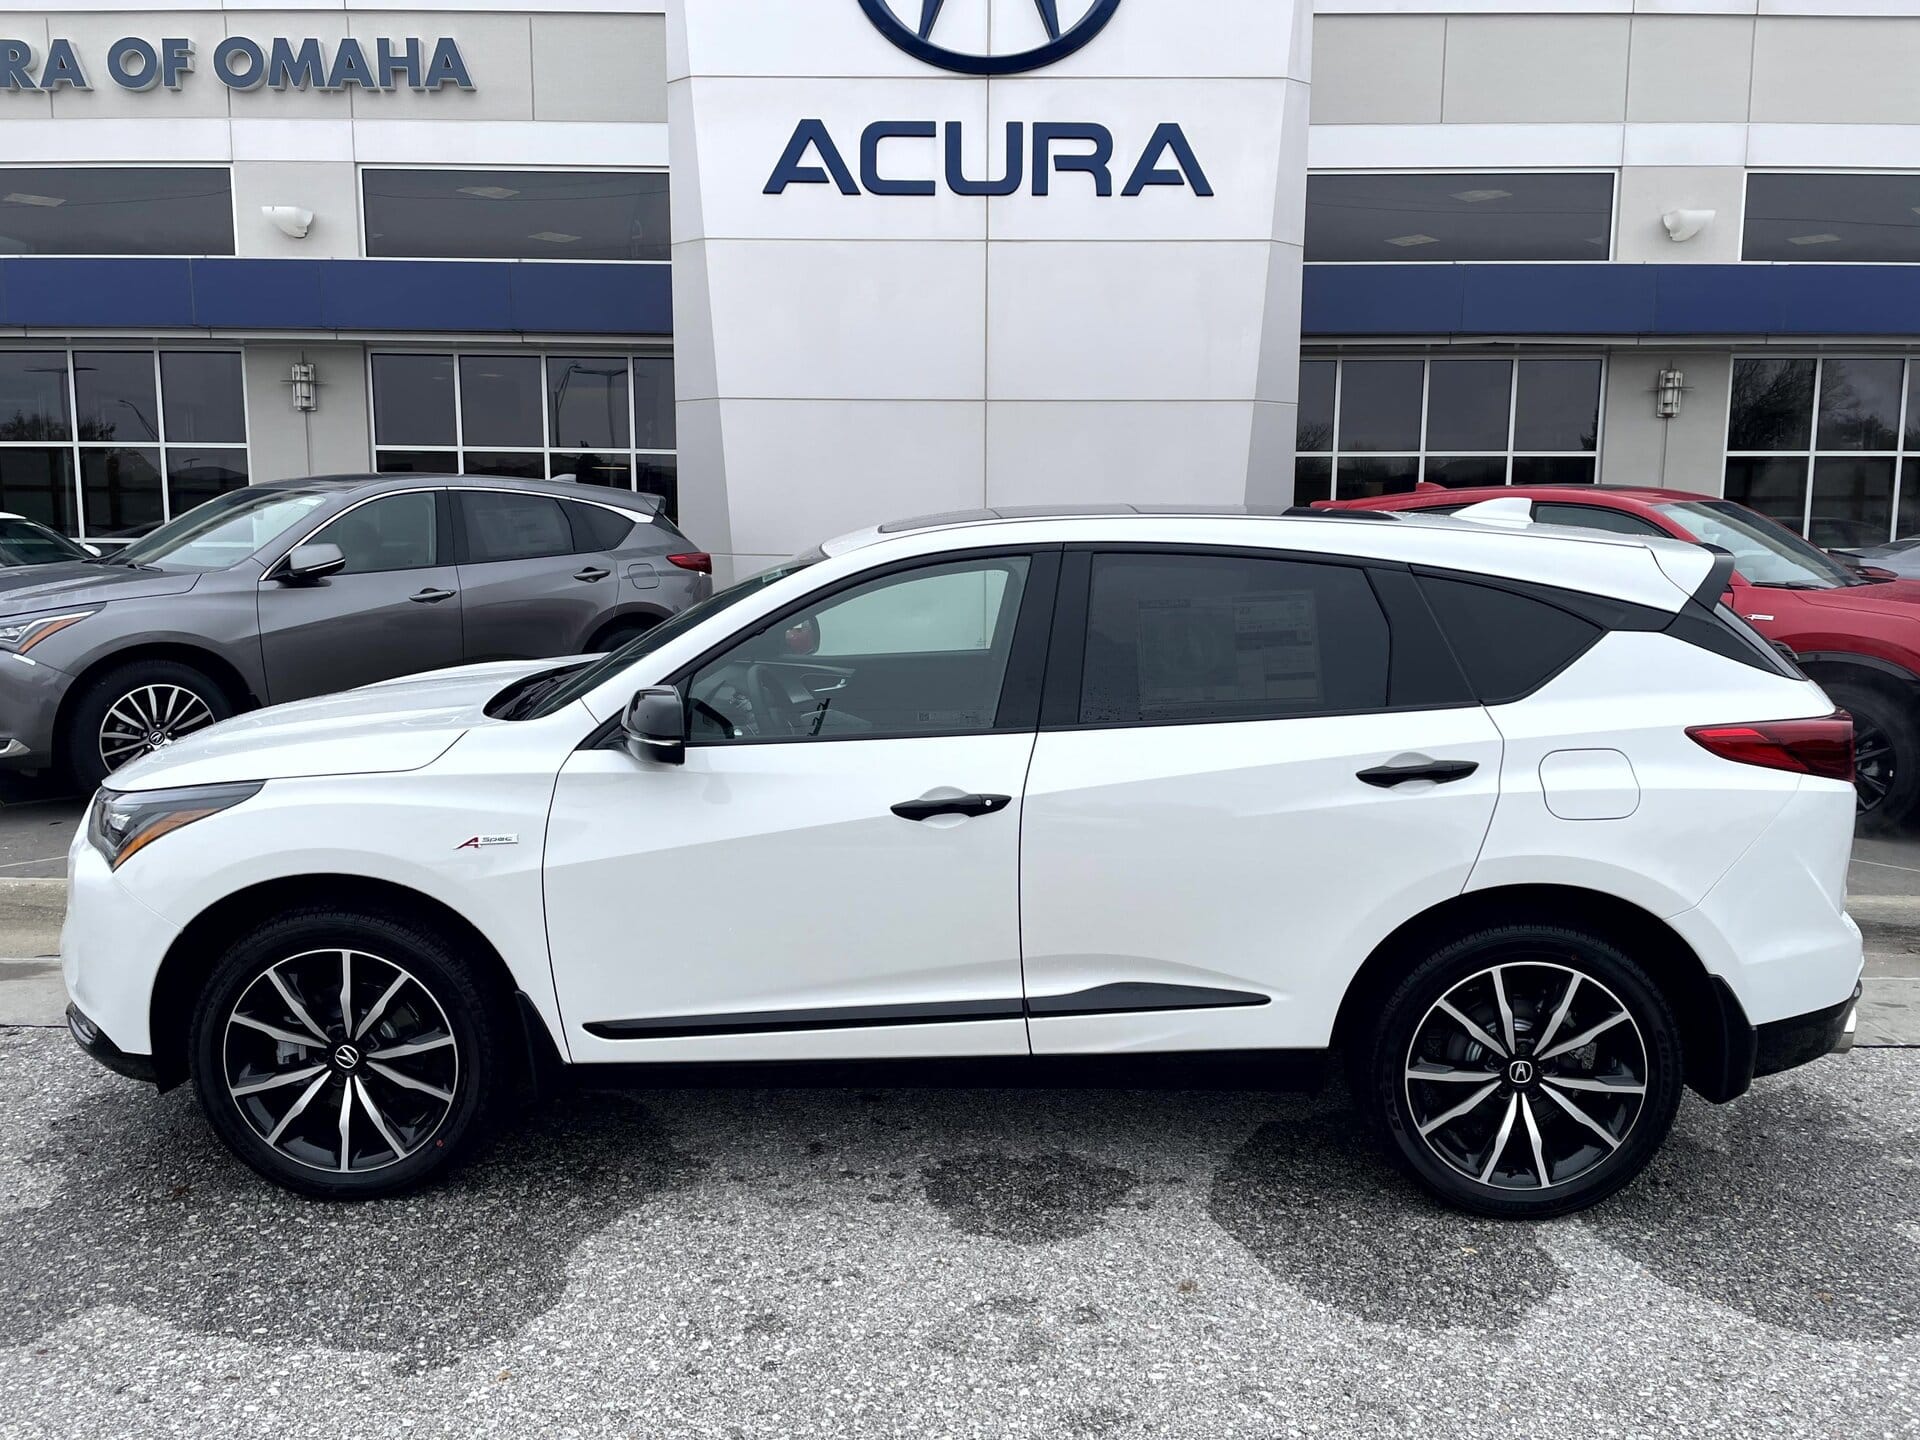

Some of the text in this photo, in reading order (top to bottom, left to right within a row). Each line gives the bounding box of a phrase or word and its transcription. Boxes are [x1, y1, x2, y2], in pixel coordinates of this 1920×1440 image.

[0, 36, 474, 91] RA OF OMAHA
[762, 118, 1214, 197] ACURA
